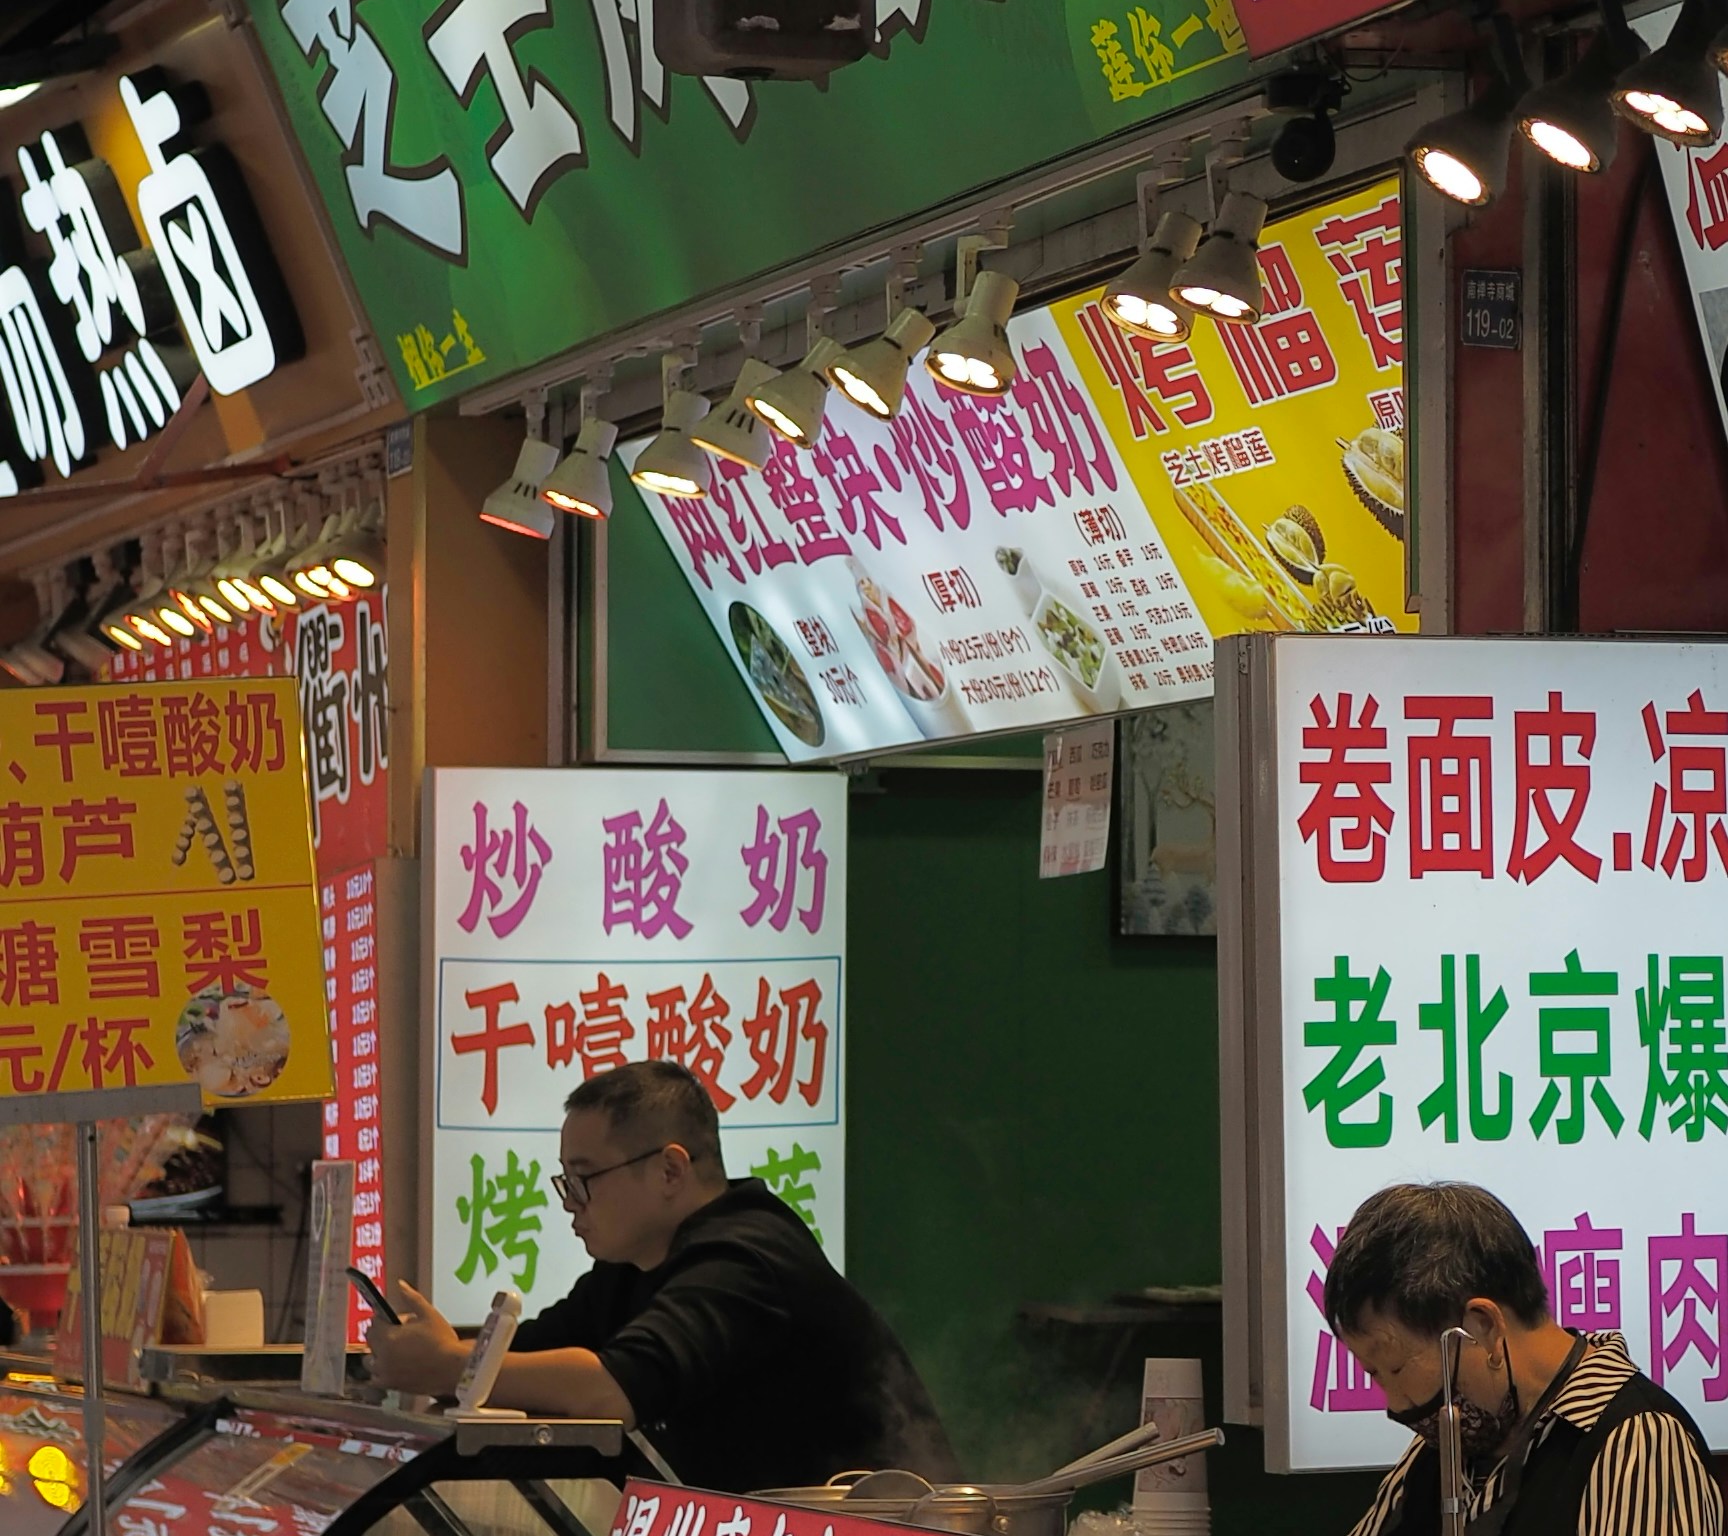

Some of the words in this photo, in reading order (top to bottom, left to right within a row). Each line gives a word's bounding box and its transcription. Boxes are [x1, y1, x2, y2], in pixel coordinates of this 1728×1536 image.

[1465, 308, 1515, 340] 119-02
[1162, 428, 1273, 486] 芝士烤榴莲
[921, 565, 983, 615] (厚切)
[456, 796, 830, 941] 炒酸奶
